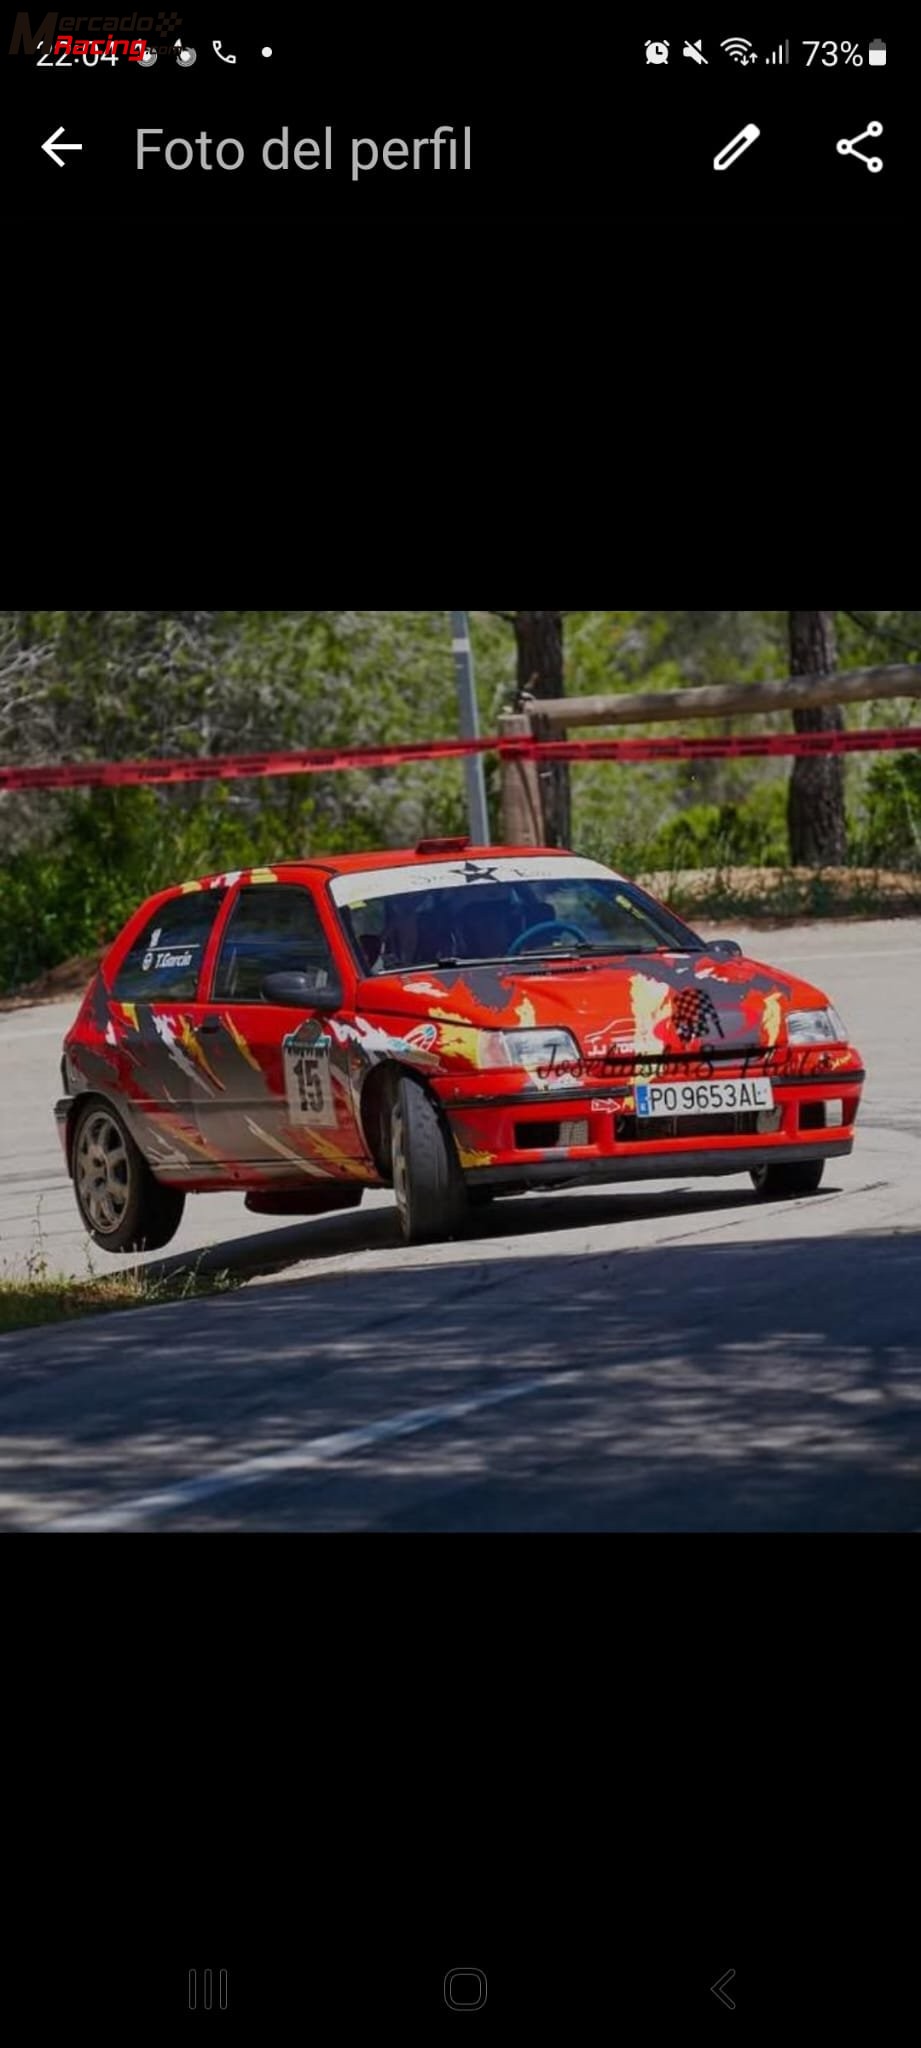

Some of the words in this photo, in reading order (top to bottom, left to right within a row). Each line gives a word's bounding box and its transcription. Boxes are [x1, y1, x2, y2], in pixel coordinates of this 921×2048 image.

[802, 41, 863, 67] 73%
[136, 128, 245, 170] Foto
[262, 126, 332, 170] del
[351, 126, 471, 181] perfil
[294, 1059, 324, 1112] 15
